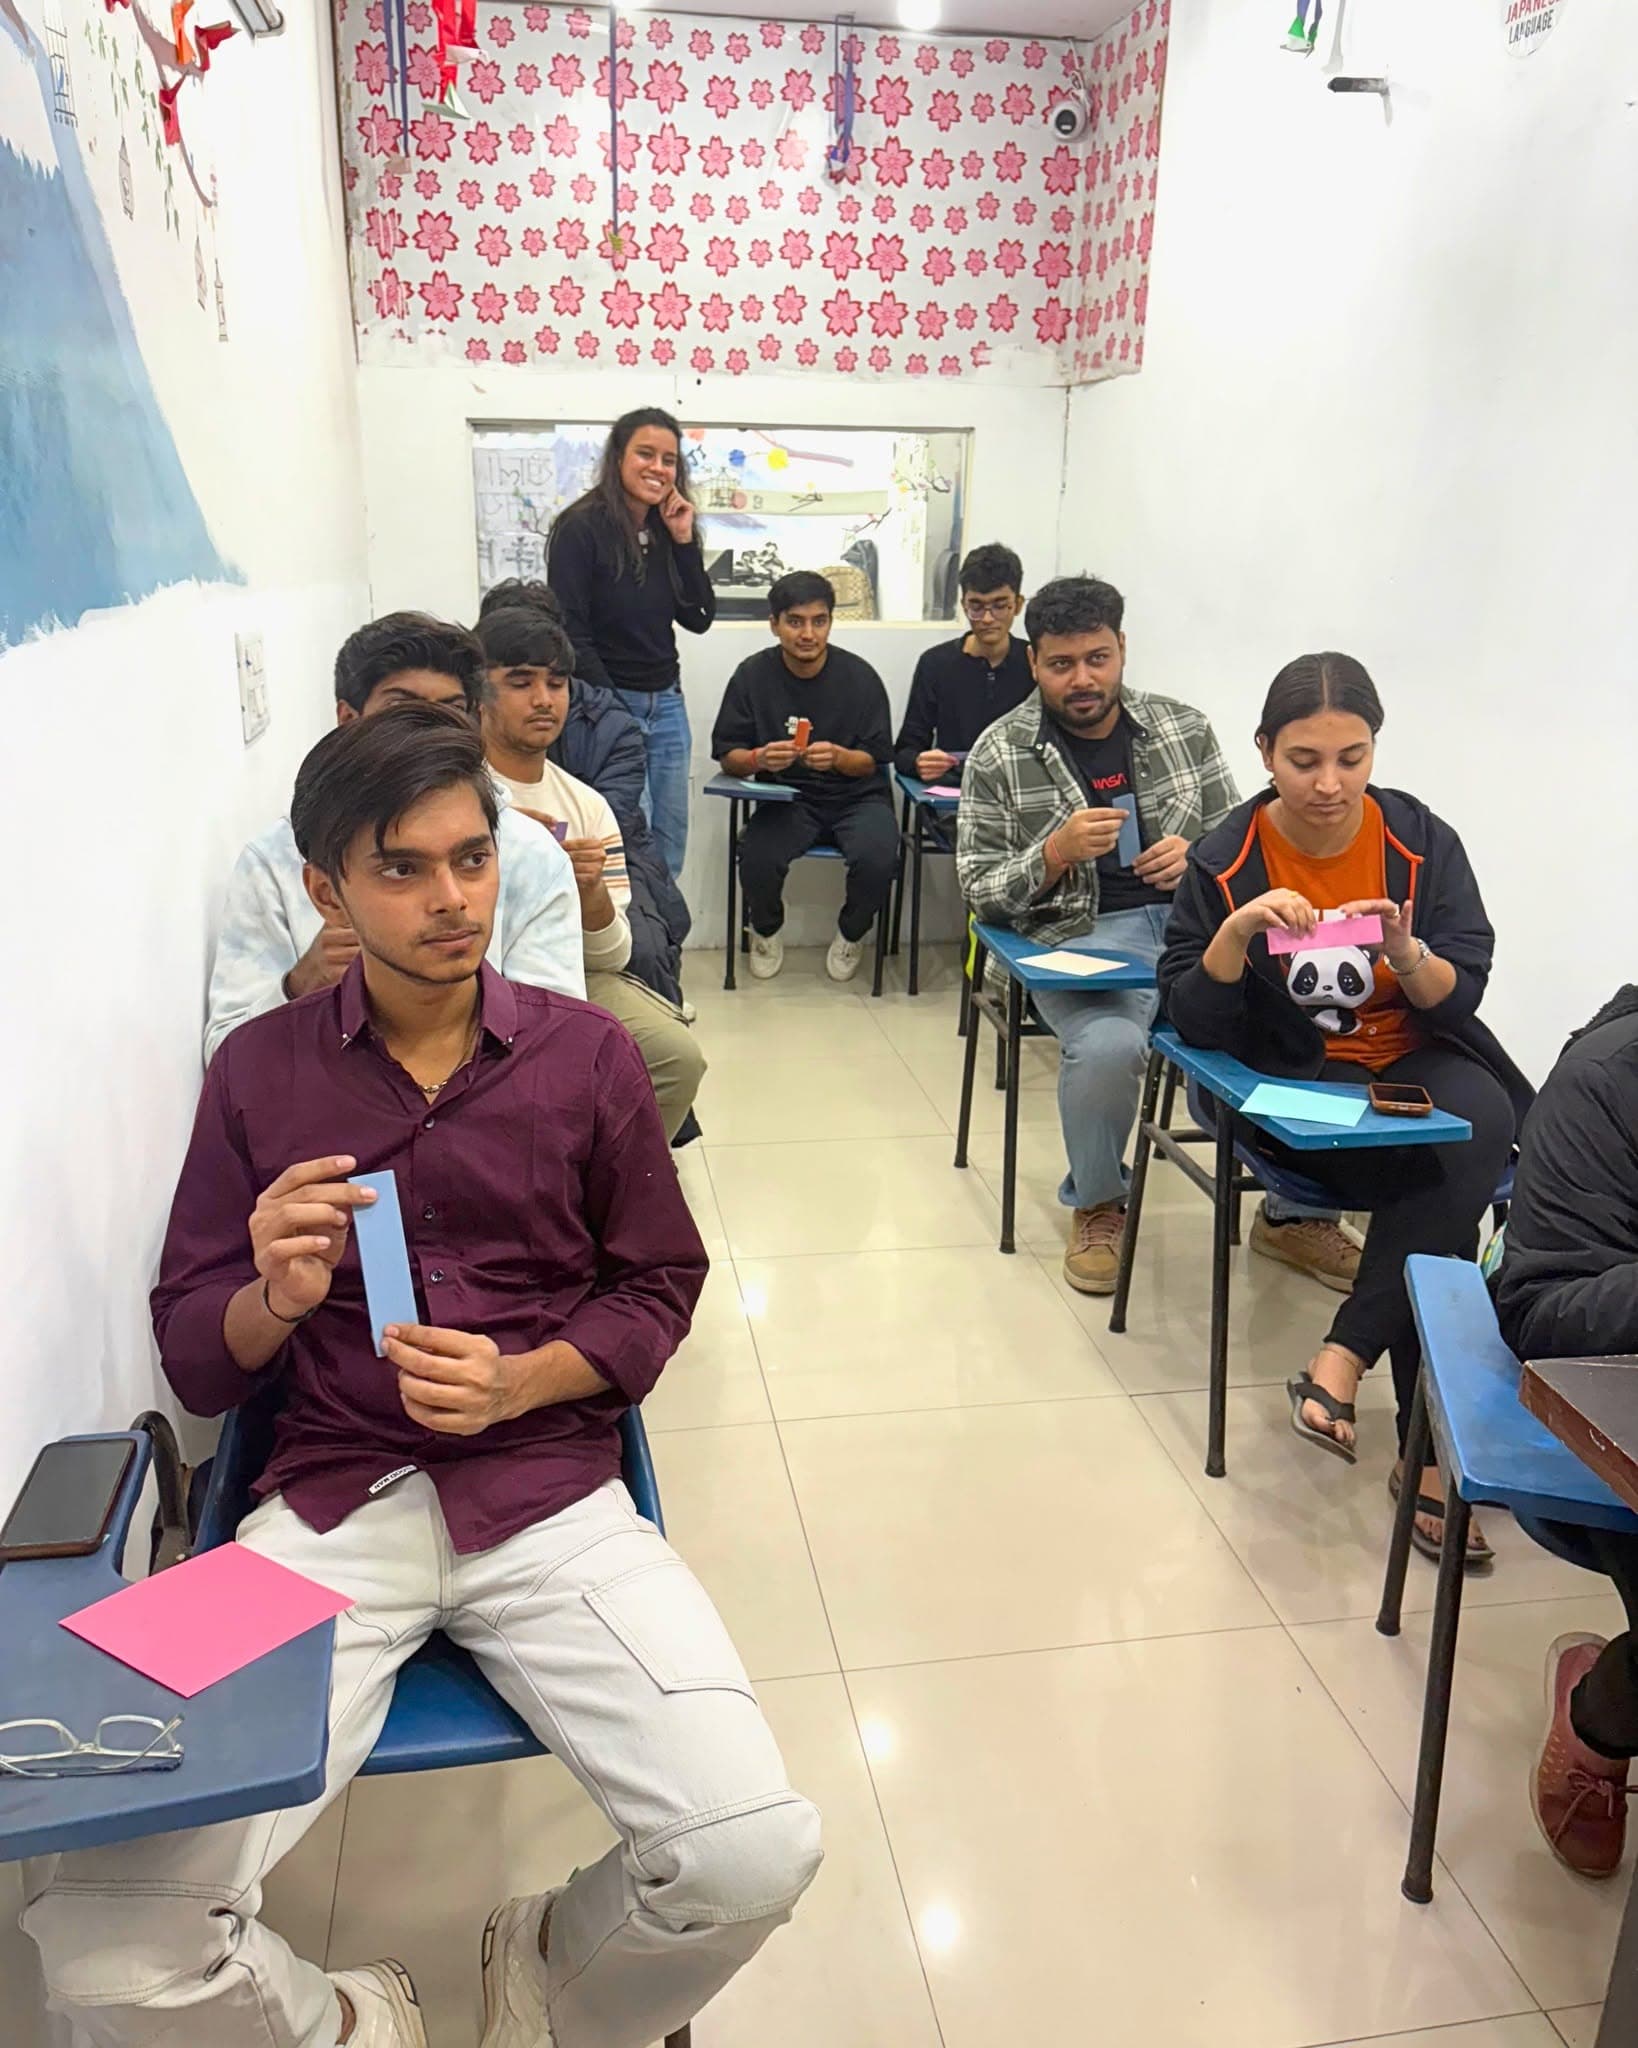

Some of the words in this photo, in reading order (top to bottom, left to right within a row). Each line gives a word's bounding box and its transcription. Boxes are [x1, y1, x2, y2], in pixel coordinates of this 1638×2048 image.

[1505, 0, 1562, 24] JAPAN
[1508, 9, 1554, 44] LANGUAGE
[1091, 773, 1128, 789] NASA
